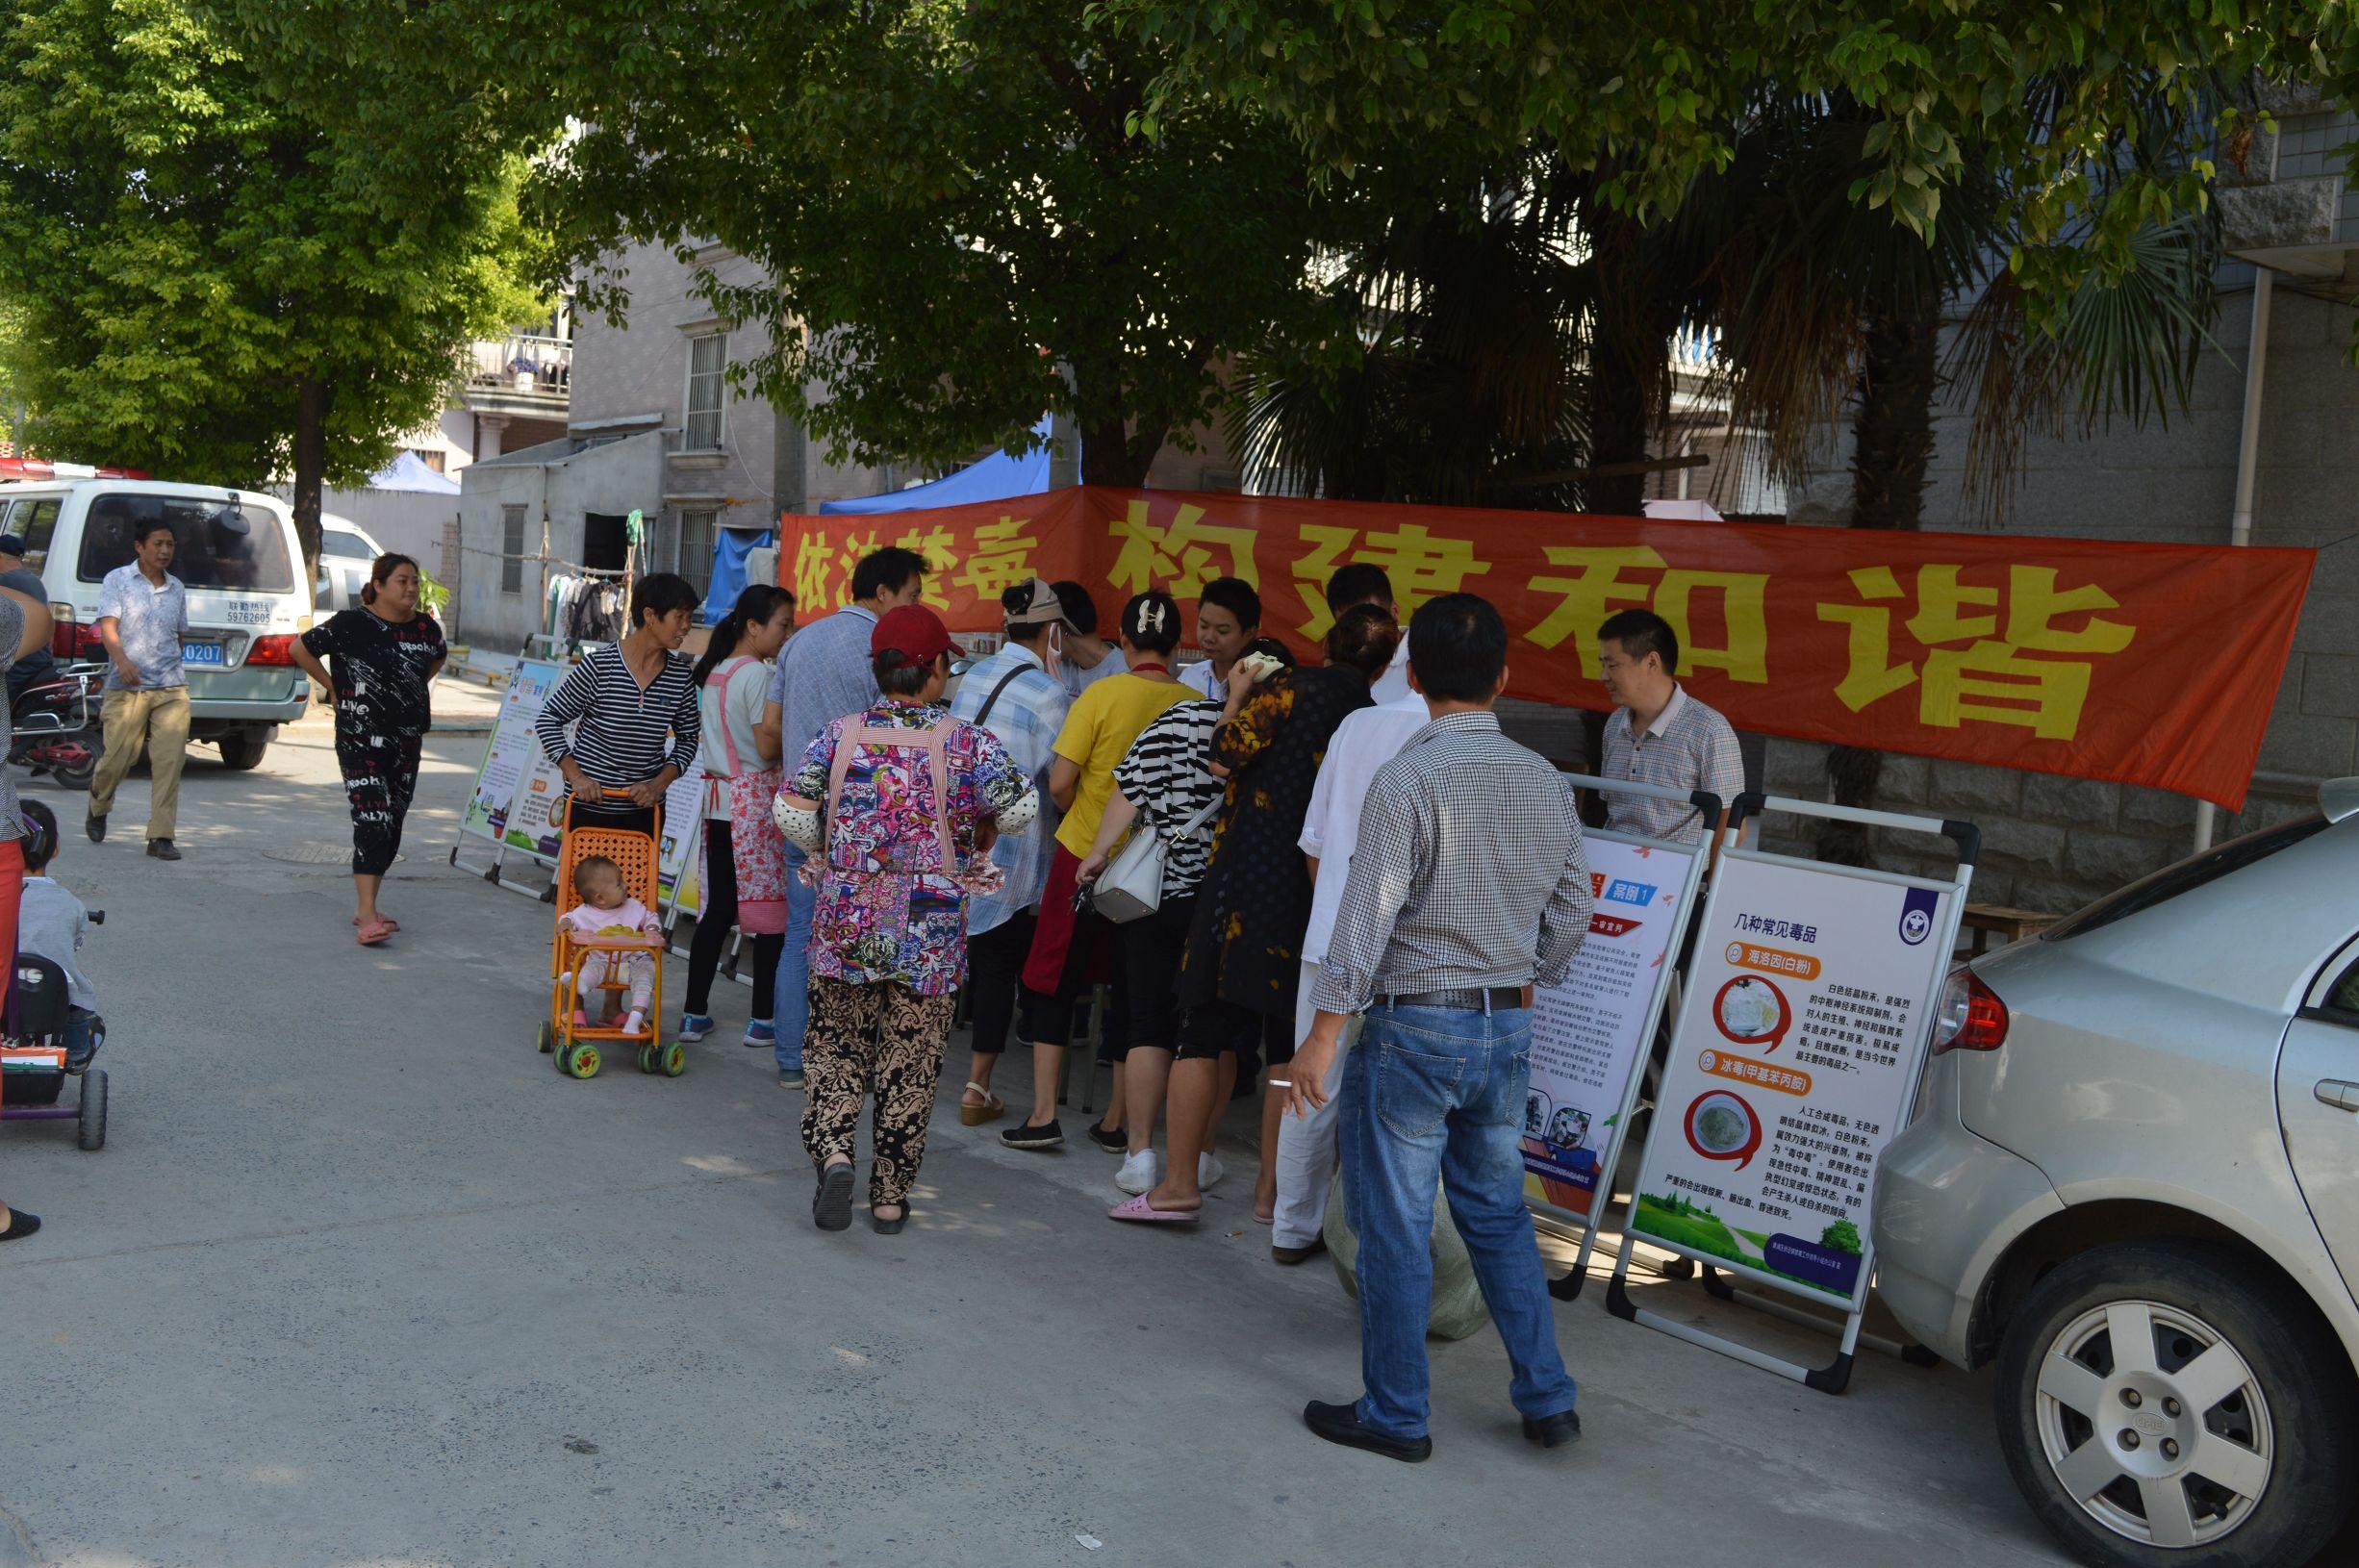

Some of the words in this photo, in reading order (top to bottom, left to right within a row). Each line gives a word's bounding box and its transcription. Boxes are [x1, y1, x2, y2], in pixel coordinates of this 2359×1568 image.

[227, 612, 270, 624] 59762605
[229, 601, 269, 613] 联勤热线
[1106, 499, 2137, 741] 构建和谐
[182, 645, 221, 662] 0207
[1613, 883, 1639, 901] 案例
[1734, 913, 1817, 944] 几种常见毒品
[1809, 994, 1907, 1024] 的中枢神经系统抑制剂，会
[1828, 984, 1911, 1009] 白色结晶粉末，是强烈
[1802, 1022, 1901, 1053] 统造成严重损害。极易成
[1805, 1008, 1904, 1038] 对人的生殖、神经和肠胃系
[1794, 1050, 1861, 1075] 最主要的毒品之一。
[1798, 1105, 1880, 1135] 人工合成毒品，无色透
[1768, 1157, 1865, 1193] 现急性中毒、精神混乱、偏
[1761, 1186, 1849, 1220] 会产生杀人或自杀的倾向。
